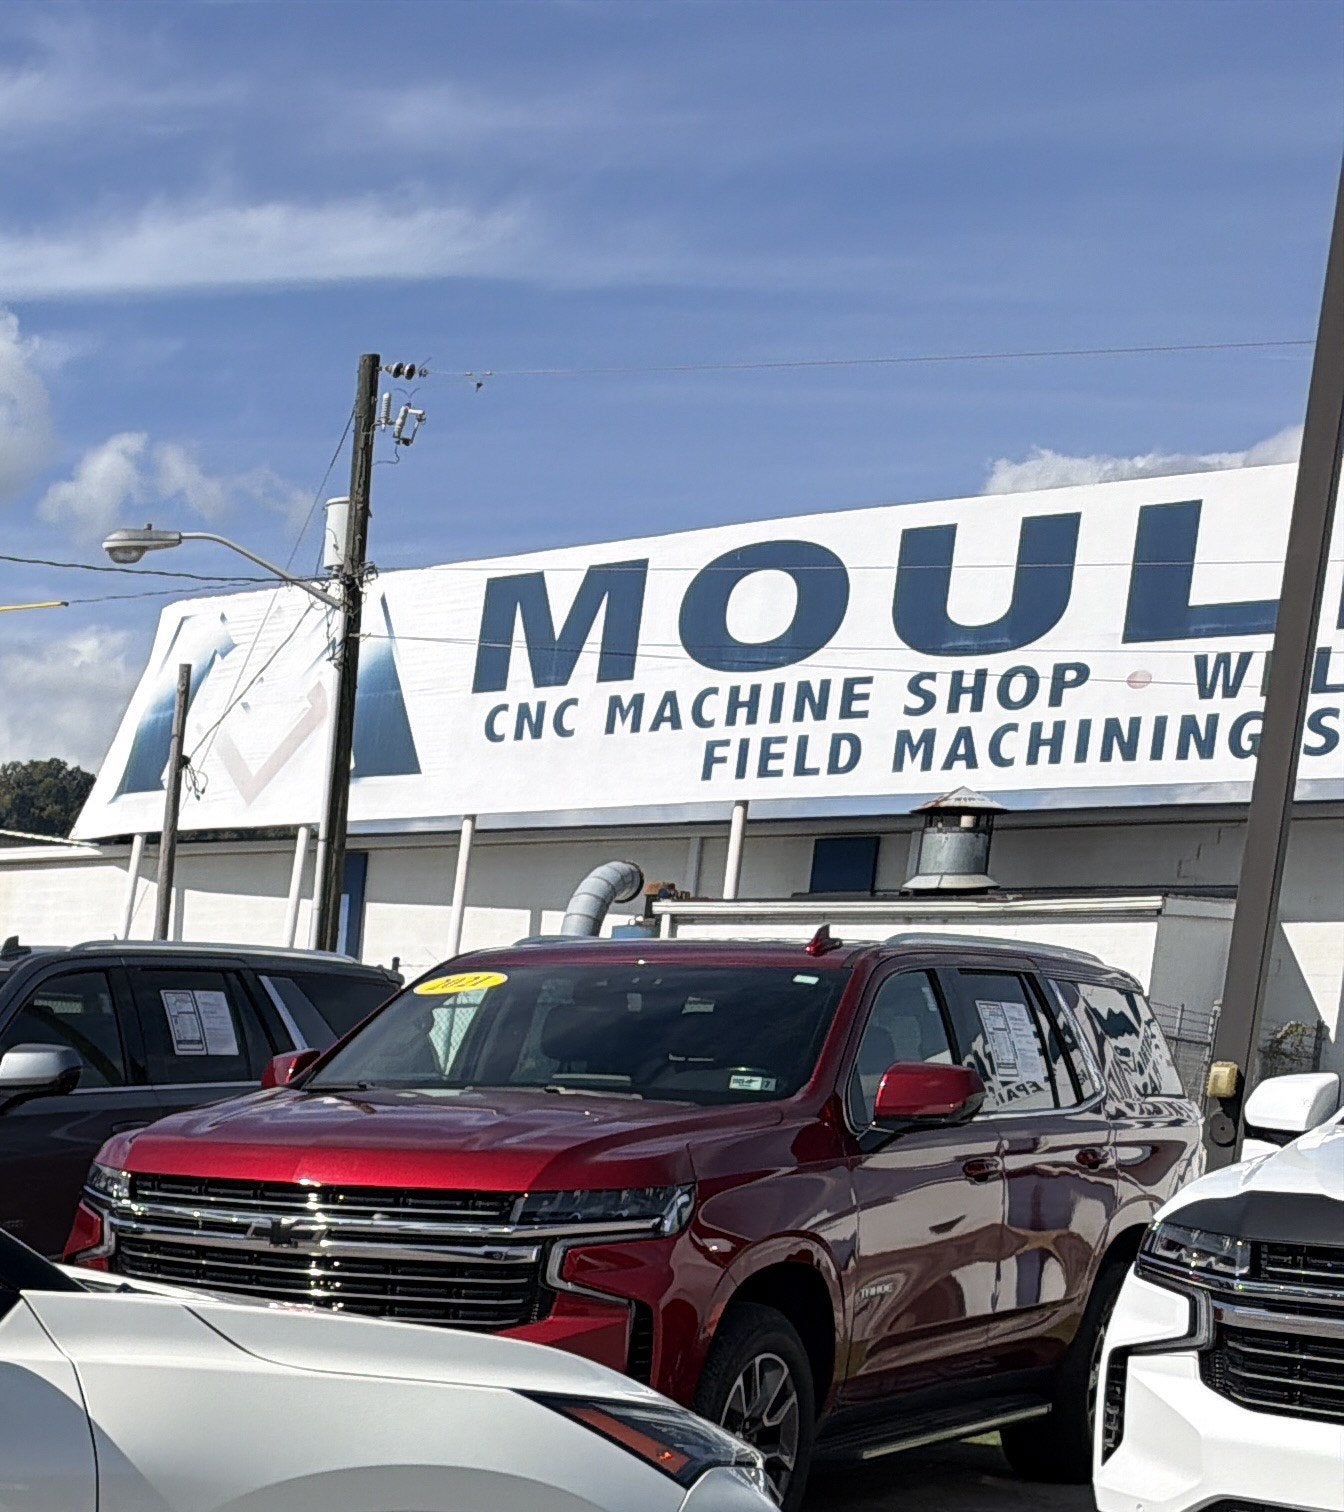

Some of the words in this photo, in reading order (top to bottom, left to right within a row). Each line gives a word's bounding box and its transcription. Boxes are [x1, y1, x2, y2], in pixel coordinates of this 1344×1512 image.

[472, 499, 1344, 692] MOUL
[484, 697, 577, 743] CNC
[606, 676, 870, 734] MACHINE
[904, 661, 1091, 716] SHOP
[1193, 645, 1344, 700] WL
[701, 732, 861, 780] FIELD
[893, 711, 1266, 772] MACHINING
